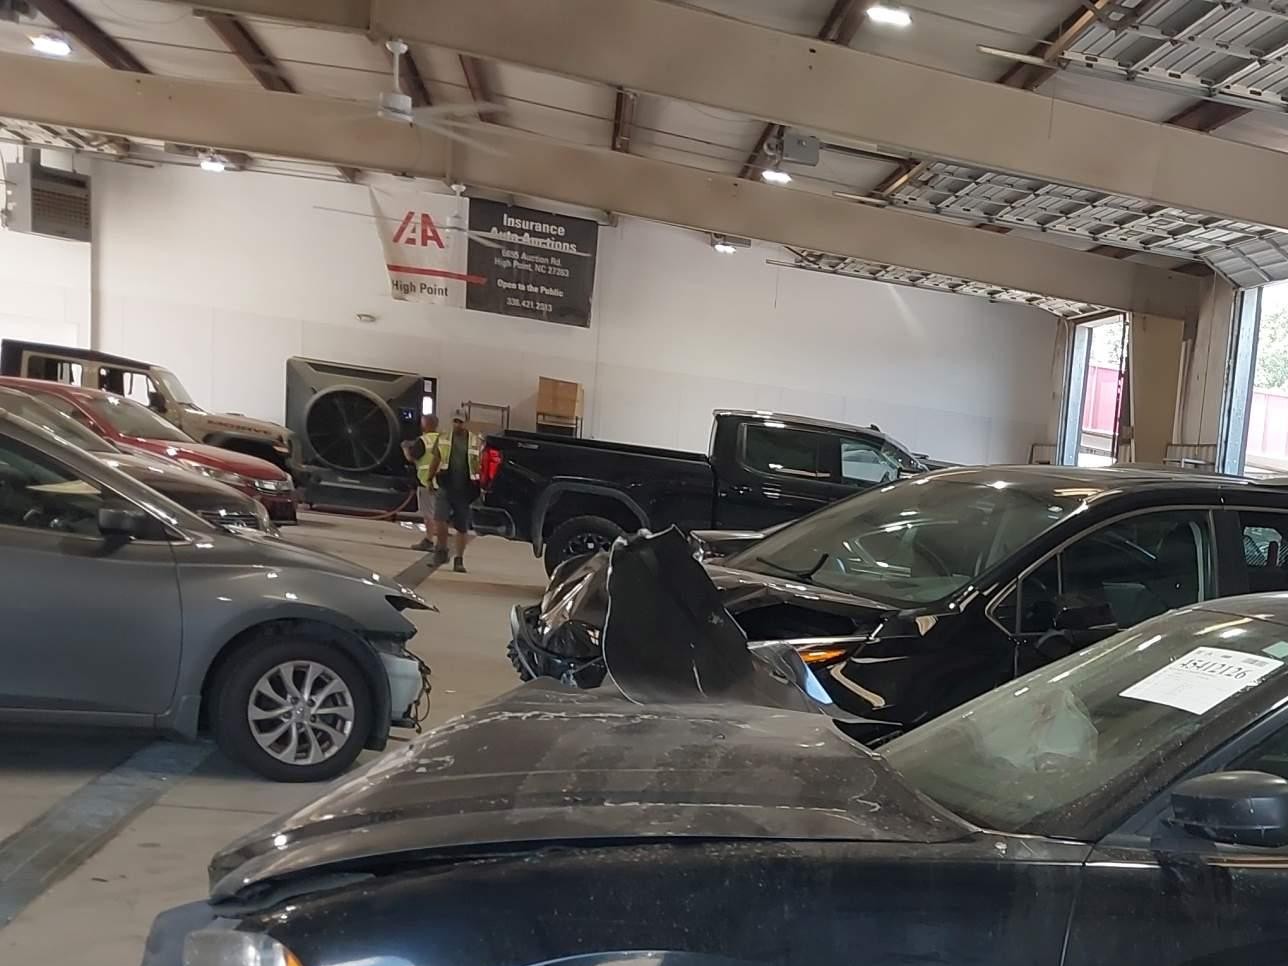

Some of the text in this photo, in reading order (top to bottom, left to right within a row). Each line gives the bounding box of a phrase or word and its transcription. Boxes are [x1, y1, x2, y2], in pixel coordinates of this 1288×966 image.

[503, 213, 565, 236] Insurance
[491, 227, 577, 252] Auto Auctions
[521, 252, 549, 264] Auction
[535, 264, 547, 274] NC
[392, 280, 448, 297] High Point
[497, 279, 564, 297] Open to the Public
